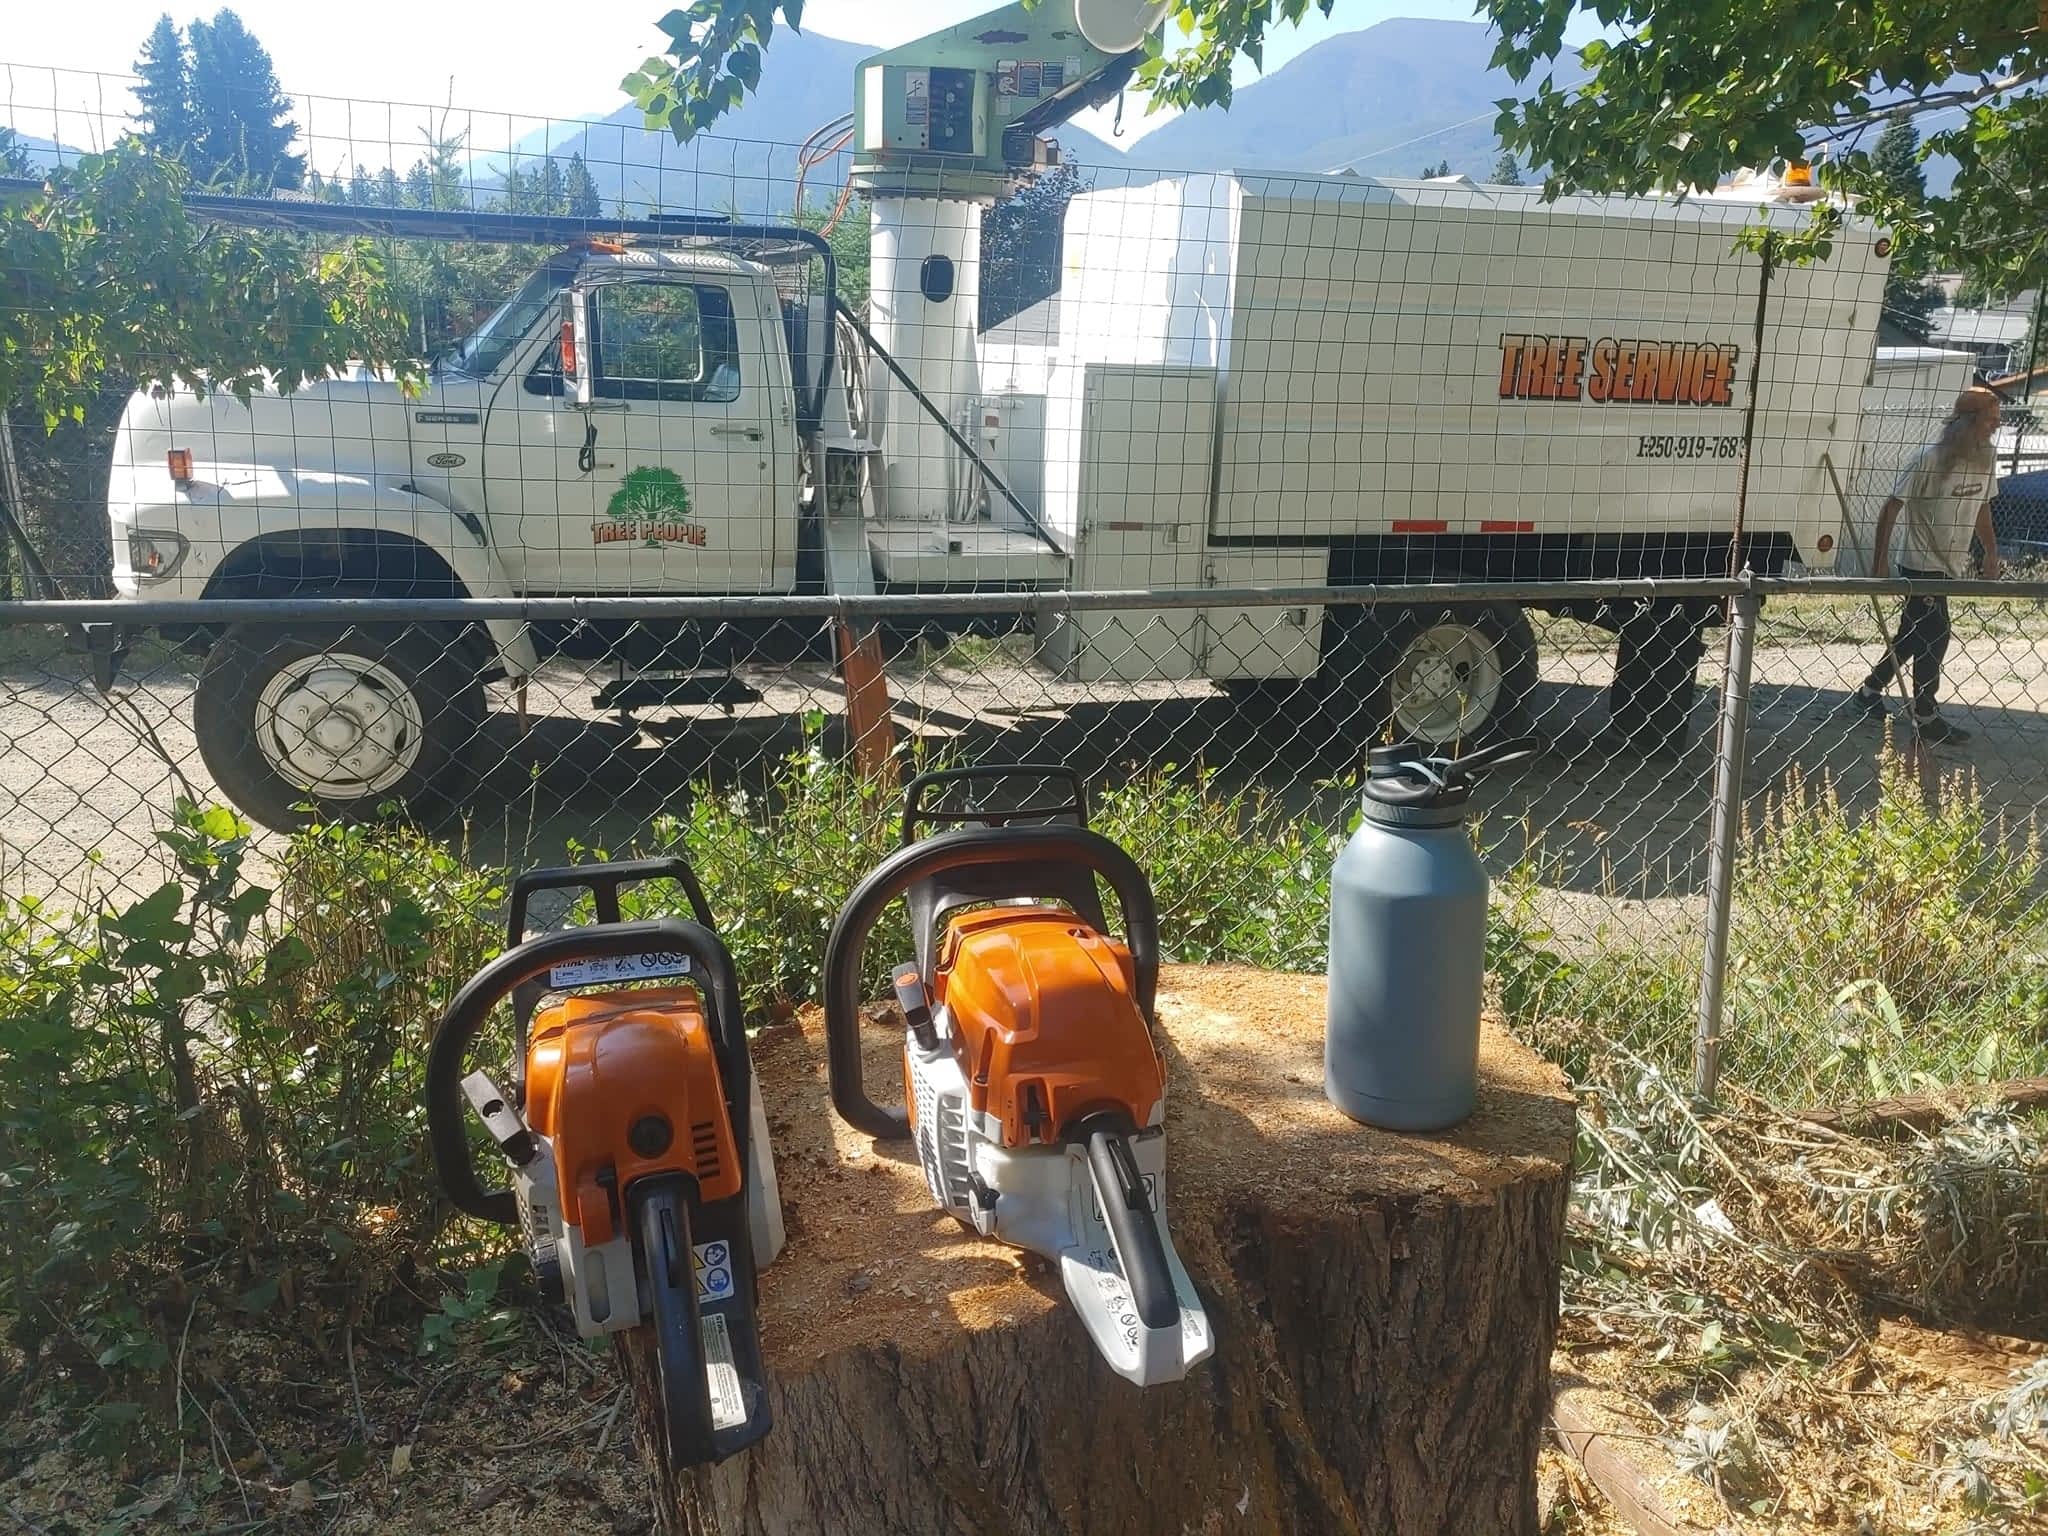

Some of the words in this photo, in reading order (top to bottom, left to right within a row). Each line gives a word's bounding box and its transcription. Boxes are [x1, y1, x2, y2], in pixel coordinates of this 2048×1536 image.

[1500, 333, 1588, 401] TREE
[1588, 336, 1738, 406] SERVICE
[591, 520, 637, 544] TREE
[640, 520, 706, 546] PEOPLE
